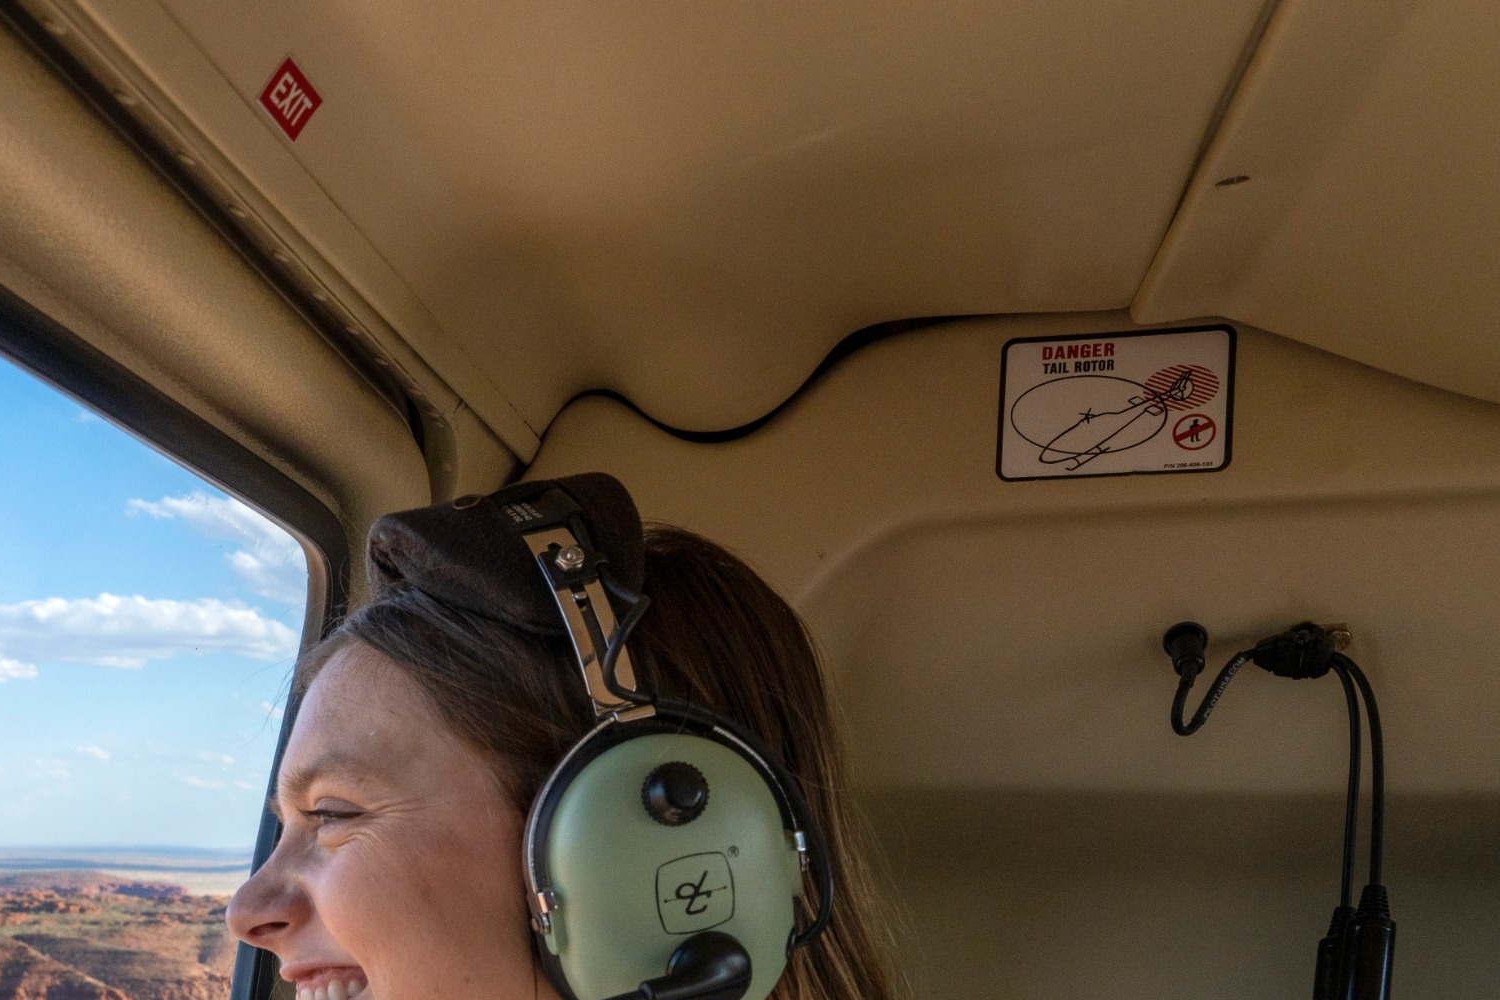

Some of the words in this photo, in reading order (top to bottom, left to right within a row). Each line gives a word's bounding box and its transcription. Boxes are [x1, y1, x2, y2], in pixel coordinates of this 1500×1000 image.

[269, 71, 313, 126] EXIT
[1042, 342, 1115, 360] DANGER
[1043, 362, 1069, 374] TAIL
[1074, 359, 1115, 373] ROTOR
